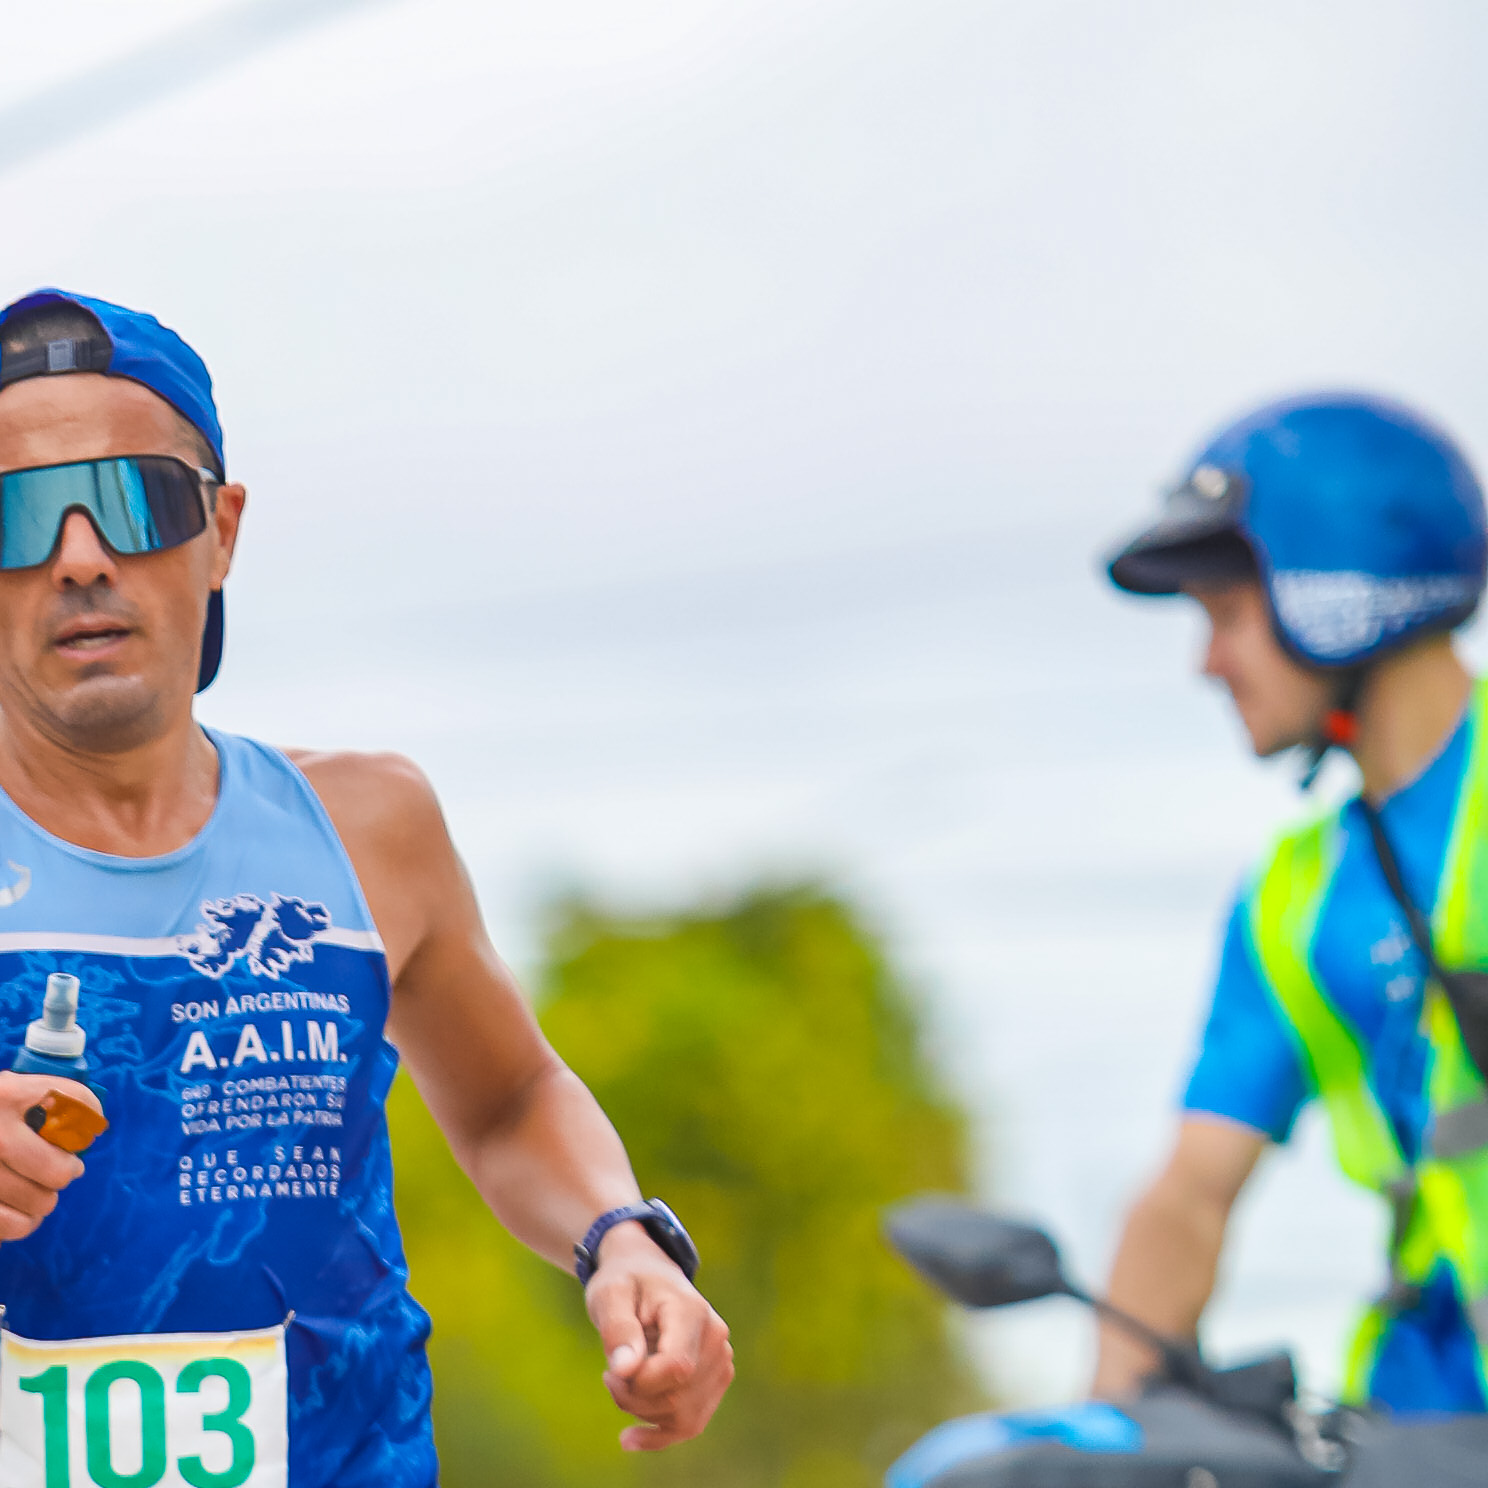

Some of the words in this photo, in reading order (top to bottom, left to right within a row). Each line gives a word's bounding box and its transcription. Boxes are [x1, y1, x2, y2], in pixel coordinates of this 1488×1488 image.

[171, 1000, 220, 1023] SON
[225, 991, 351, 1018] ARGENTINAS
[180, 1020, 348, 1073] A.A.I.M.
[222, 1075, 347, 1096] COMBATIENTES
[181, 1092, 318, 1118] OFRENDARON
[181, 1117, 222, 1136] VIDA
[225, 1112, 262, 1130] POR
[266, 1111, 290, 1128] LA
[293, 1109, 344, 1128] PATRIA
[179, 1149, 239, 1172] QUE
[274, 1145, 341, 1164] SEAN
[179, 1163, 341, 1188] RECORDADOS
[179, 1181, 339, 1206] ETERNAMENTE
